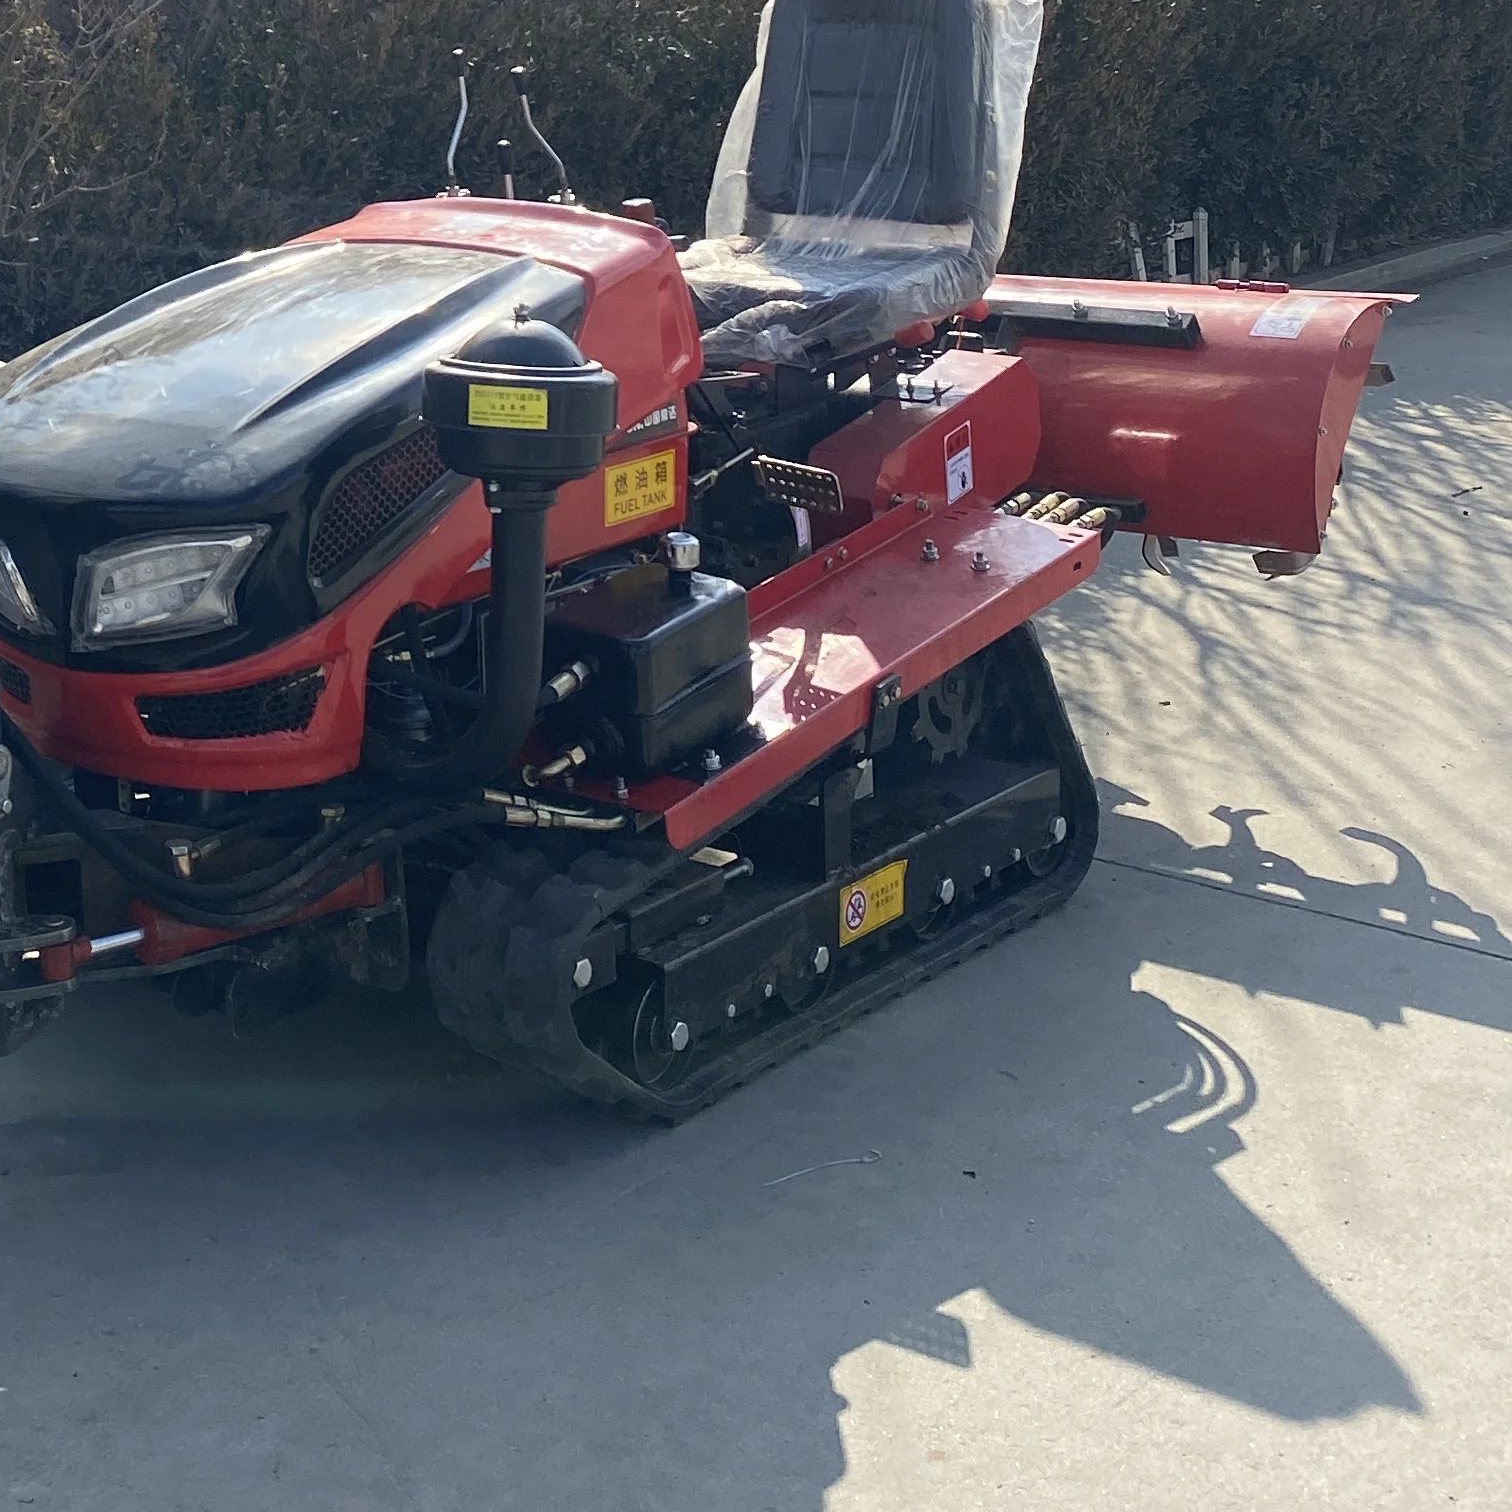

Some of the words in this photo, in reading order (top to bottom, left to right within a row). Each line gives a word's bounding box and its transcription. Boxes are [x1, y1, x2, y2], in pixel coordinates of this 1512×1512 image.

[615, 461, 667, 497] 燃油箱
[614, 498, 640, 516] FUEL
[642, 489, 667, 506] TANK
